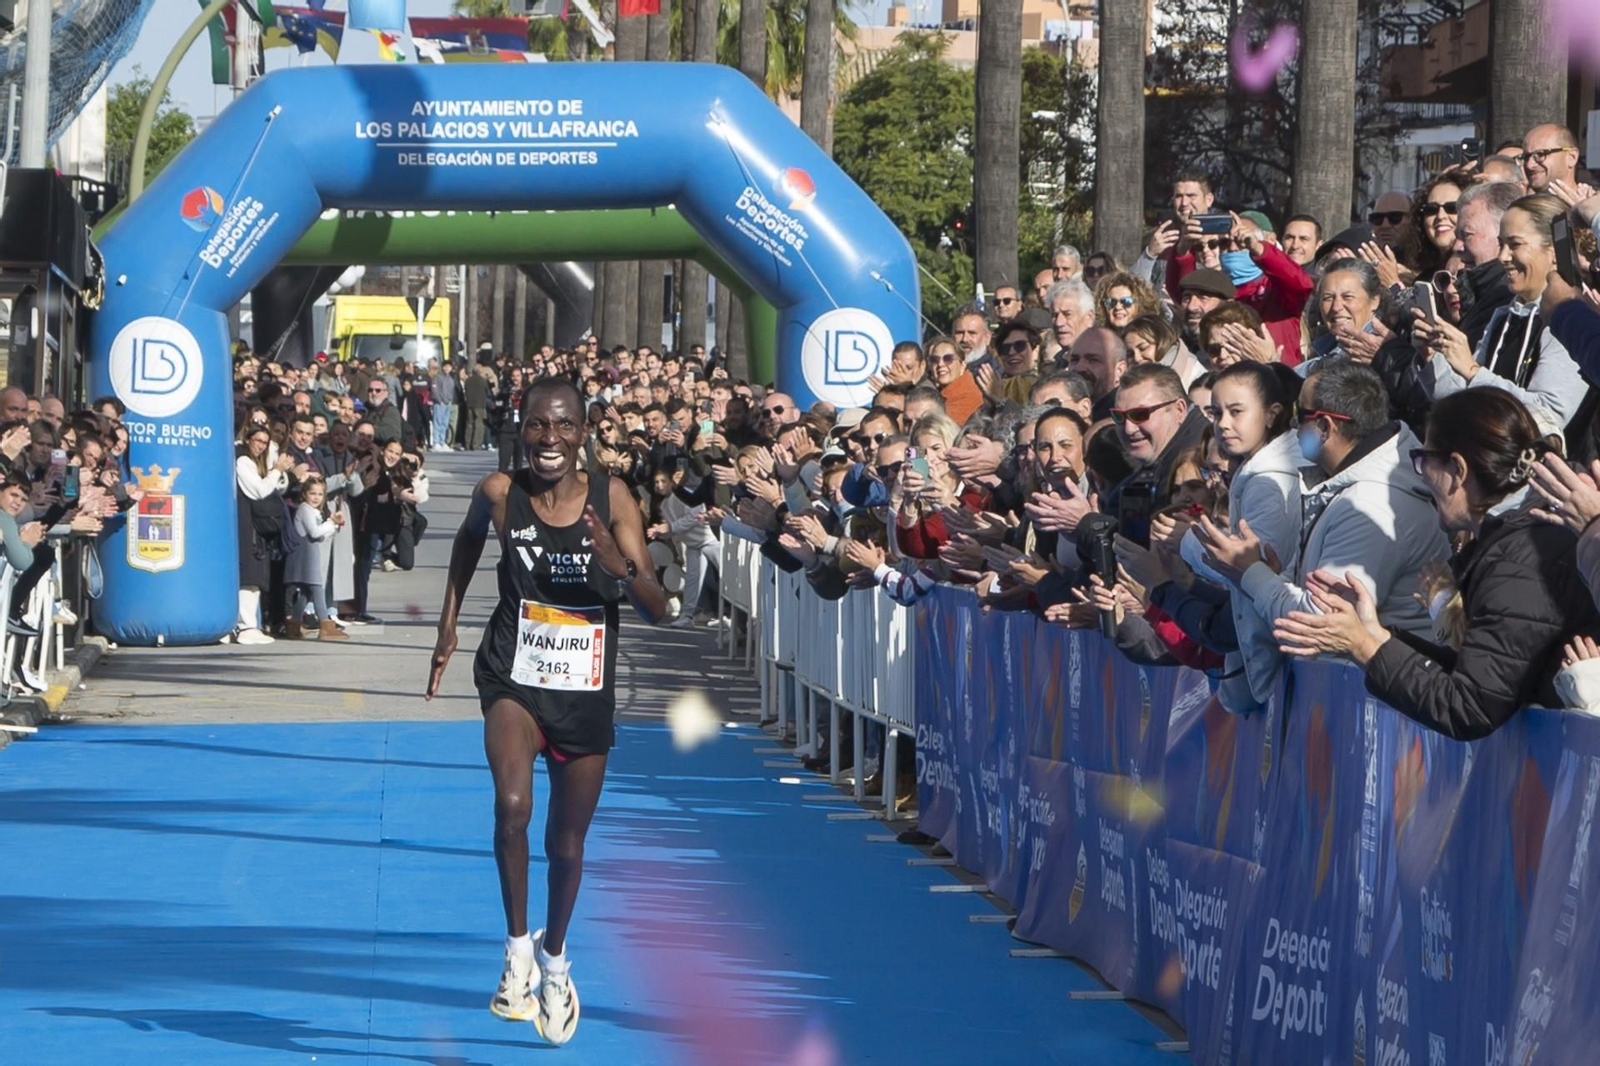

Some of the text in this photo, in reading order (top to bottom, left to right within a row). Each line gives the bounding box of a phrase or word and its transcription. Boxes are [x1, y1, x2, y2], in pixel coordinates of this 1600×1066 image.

[411, 100, 583, 116] AYUNTAMIENTO DE
[355, 120, 639, 138] LOS PALACIOS Y VILLAFRANCA
[398, 150, 598, 166] DELEGACIÓN DE DEPORTES
[742, 186, 804, 234] Delegación
[199, 200, 248, 262] Delegación
[735, 195, 805, 251] Deportes
[206, 200, 264, 269] Deportes
[162, 424, 212, 439] BUENO
[546, 553, 592, 565] VICKY
[551, 566, 588, 574] FOODS
[522, 632, 589, 651] WANJIRU
[536, 660, 570, 674] 2162
